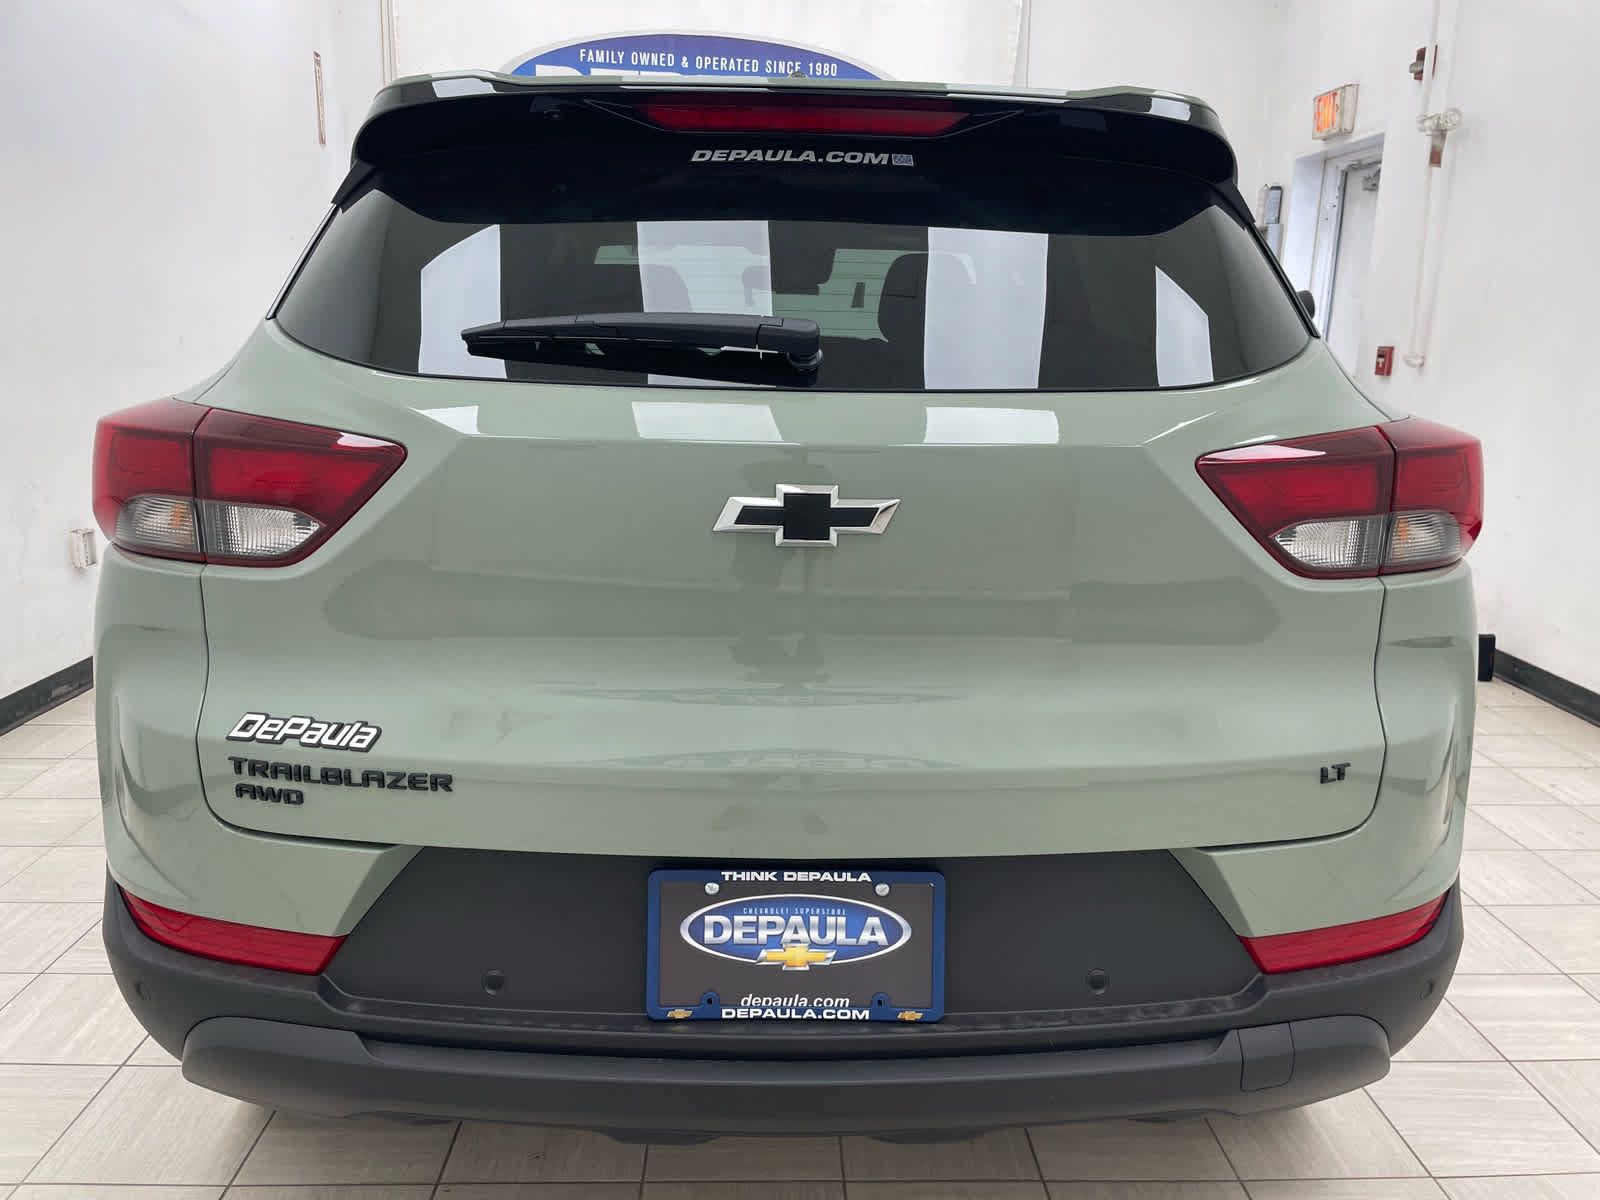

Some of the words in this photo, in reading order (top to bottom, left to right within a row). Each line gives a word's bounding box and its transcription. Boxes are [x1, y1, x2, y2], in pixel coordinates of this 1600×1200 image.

[579, 48, 625, 65] FAMILY
[631, 51, 675, 67] OWNED
[681, 56, 689, 69] &
[695, 56, 759, 73] OPERATED
[765, 60, 802, 74] SINCE
[808, 62, 838, 77] 1980
[1315, 91, 1338, 132] EXIT
[690, 149, 889, 165] DEPAULA.COM
[226, 711, 382, 753] DePaula
[227, 756, 454, 793] TRAILBLAZER
[1320, 762, 1351, 784] LT
[234, 783, 305, 806] AWD
[721, 871, 778, 882] THINK
[783, 872, 872, 882] DEPAULA
[743, 907, 790, 915] CHEVROLET
[703, 915, 889, 946] DEPAULA
[740, 993, 850, 1008] depaula.com
[721, 1008, 870, 1020] DEPAULA.COM
